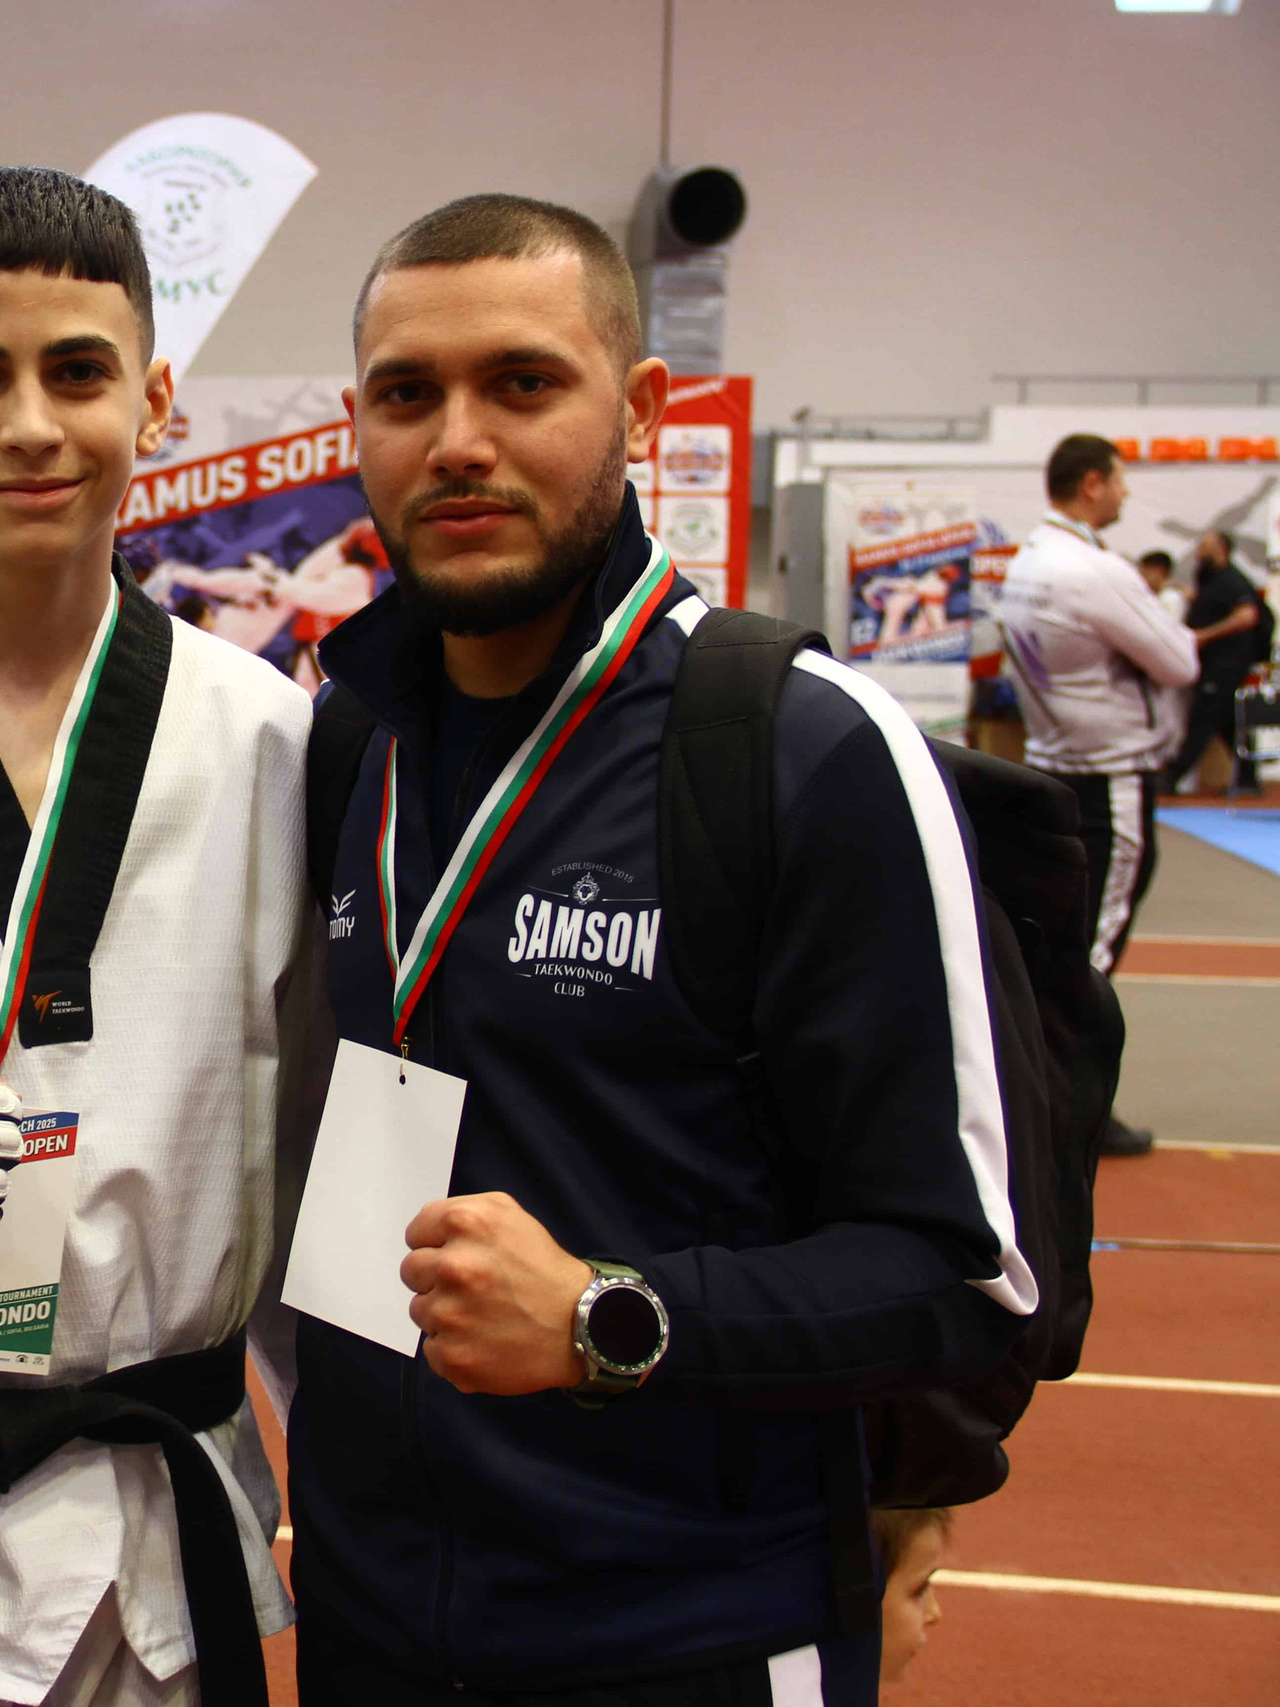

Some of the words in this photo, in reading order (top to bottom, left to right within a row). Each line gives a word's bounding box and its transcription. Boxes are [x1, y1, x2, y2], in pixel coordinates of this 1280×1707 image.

[115, 455, 247, 528] AMUS
[551, 862, 612, 876] ESTABLISHED
[613, 869, 635, 883] 2015
[329, 916, 355, 941] TOMY
[507, 893, 662, 981] SAMSON
[534, 963, 613, 986] TAEKWONDO
[554, 982, 586, 997] CLUB
[36, 1117, 57, 1130] 2025
[24, 1134, 69, 1156] OPEN
